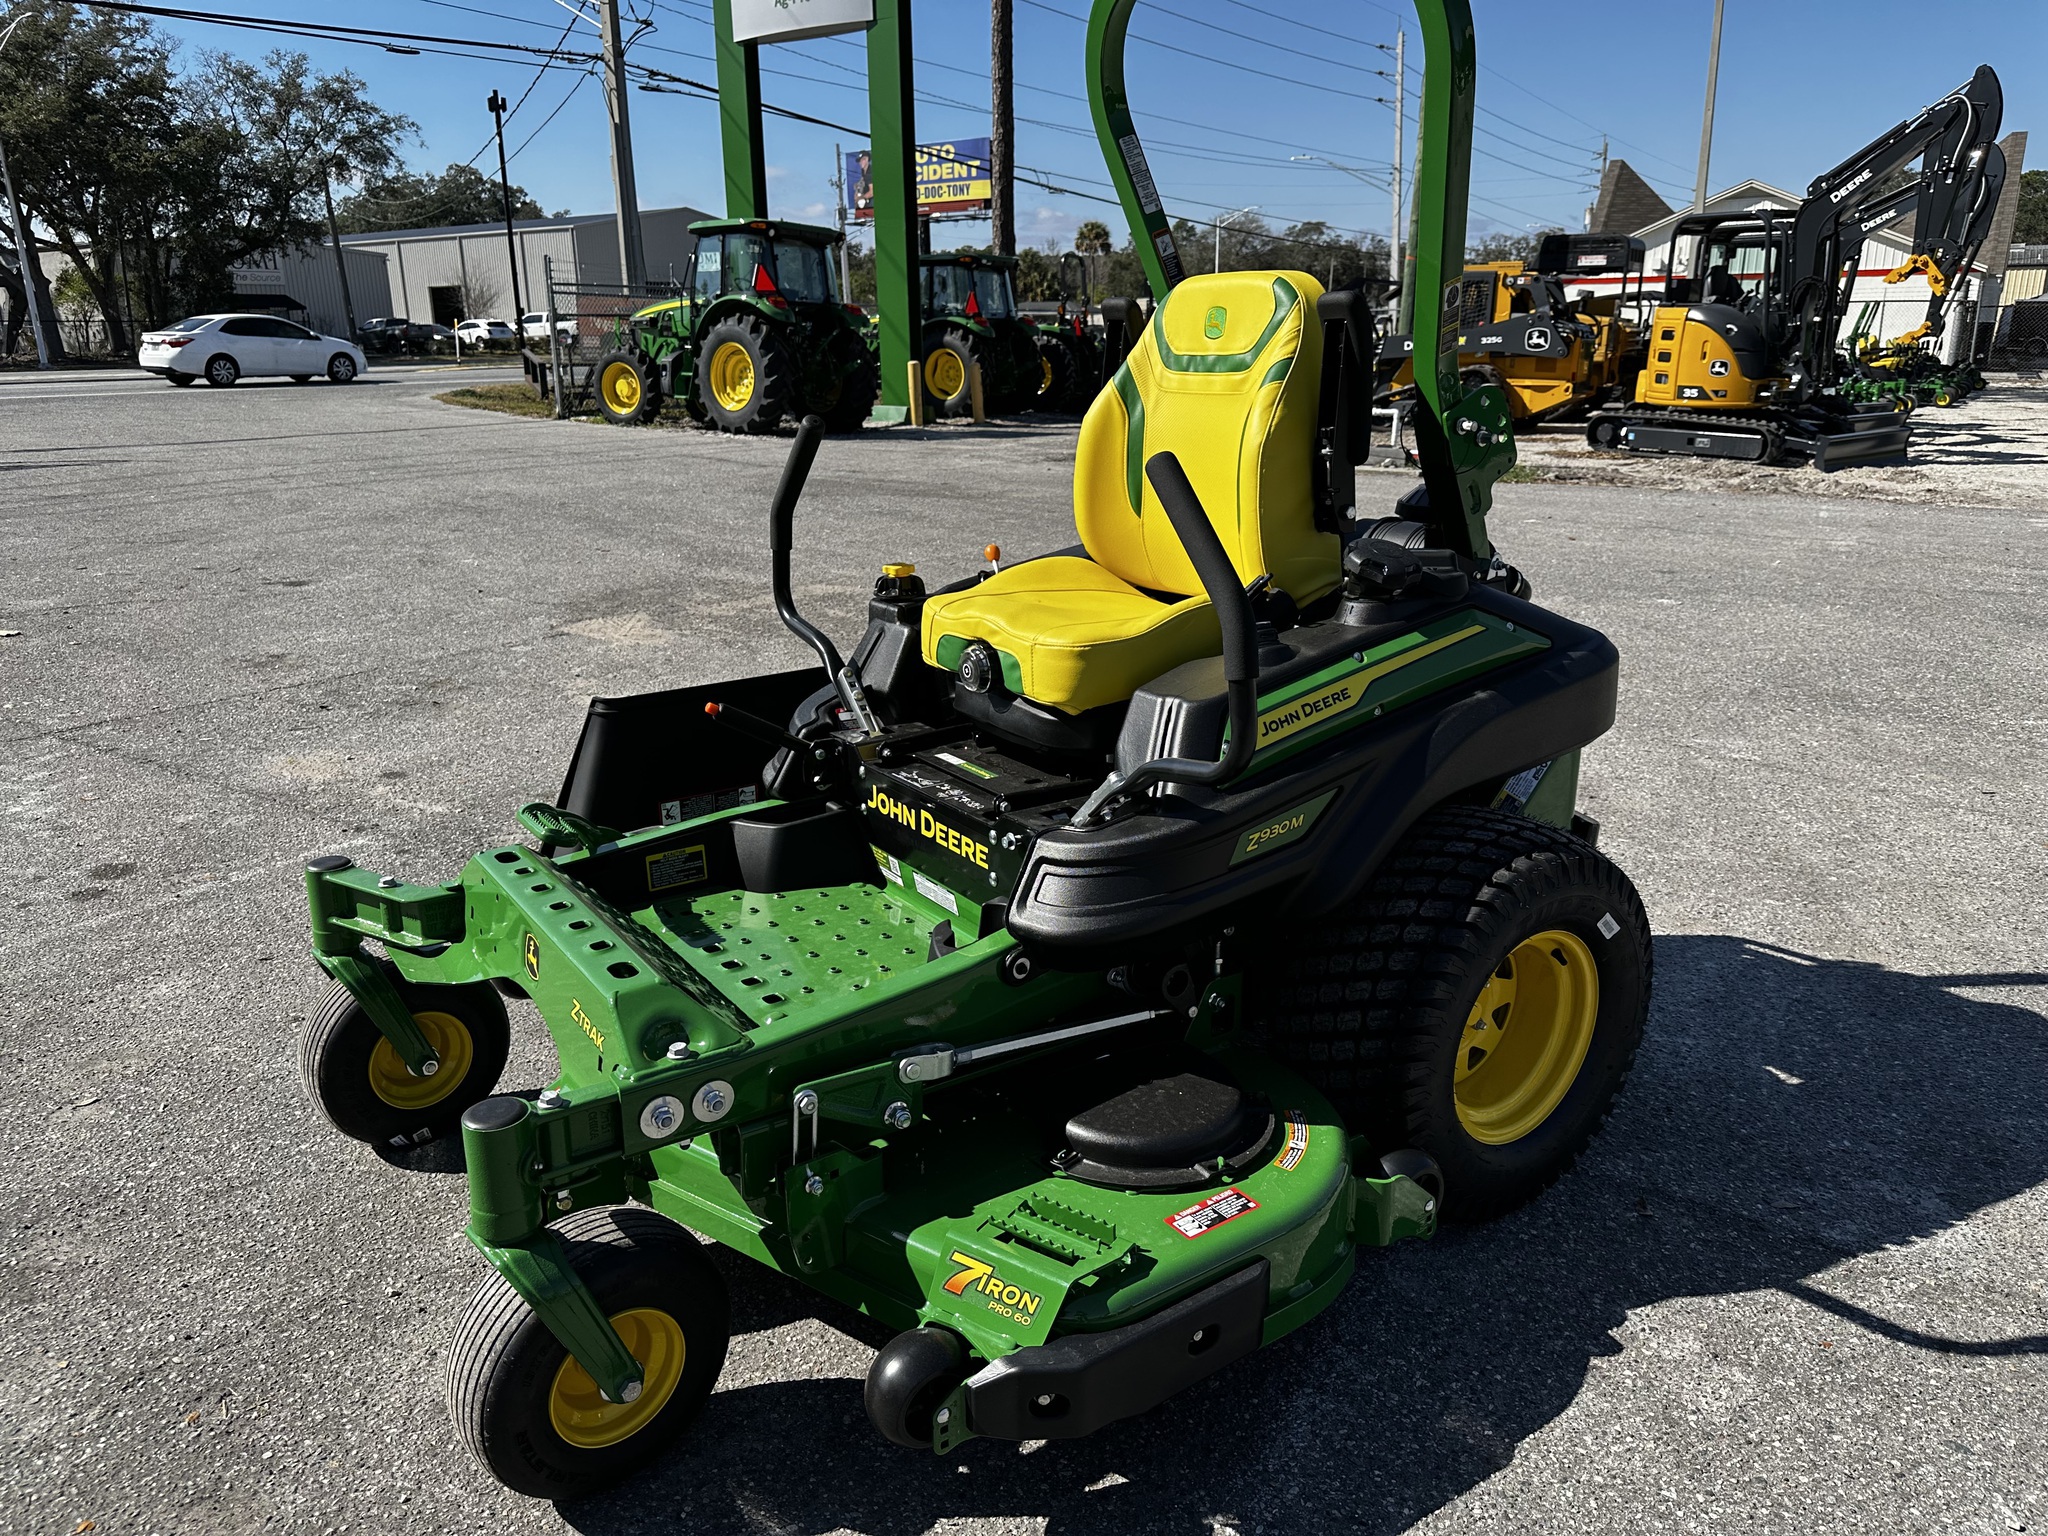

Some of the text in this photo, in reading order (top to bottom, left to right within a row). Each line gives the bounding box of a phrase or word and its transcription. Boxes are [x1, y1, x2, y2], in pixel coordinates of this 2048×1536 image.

[1829, 168, 1873, 204] DEERE
[1860, 208, 1897, 232] DEERE
[250, 273, 281, 282] Source
[1682, 388, 1699, 398] 35
[1261, 687, 1352, 738] JOHN DEERE
[867, 784, 916, 831] JOHN
[920, 808, 989, 870] DEERE
[1246, 813, 1305, 852] Z930M
[570, 998, 606, 1054] ZTRAK
[987, 1300, 1031, 1326] PRO 60
